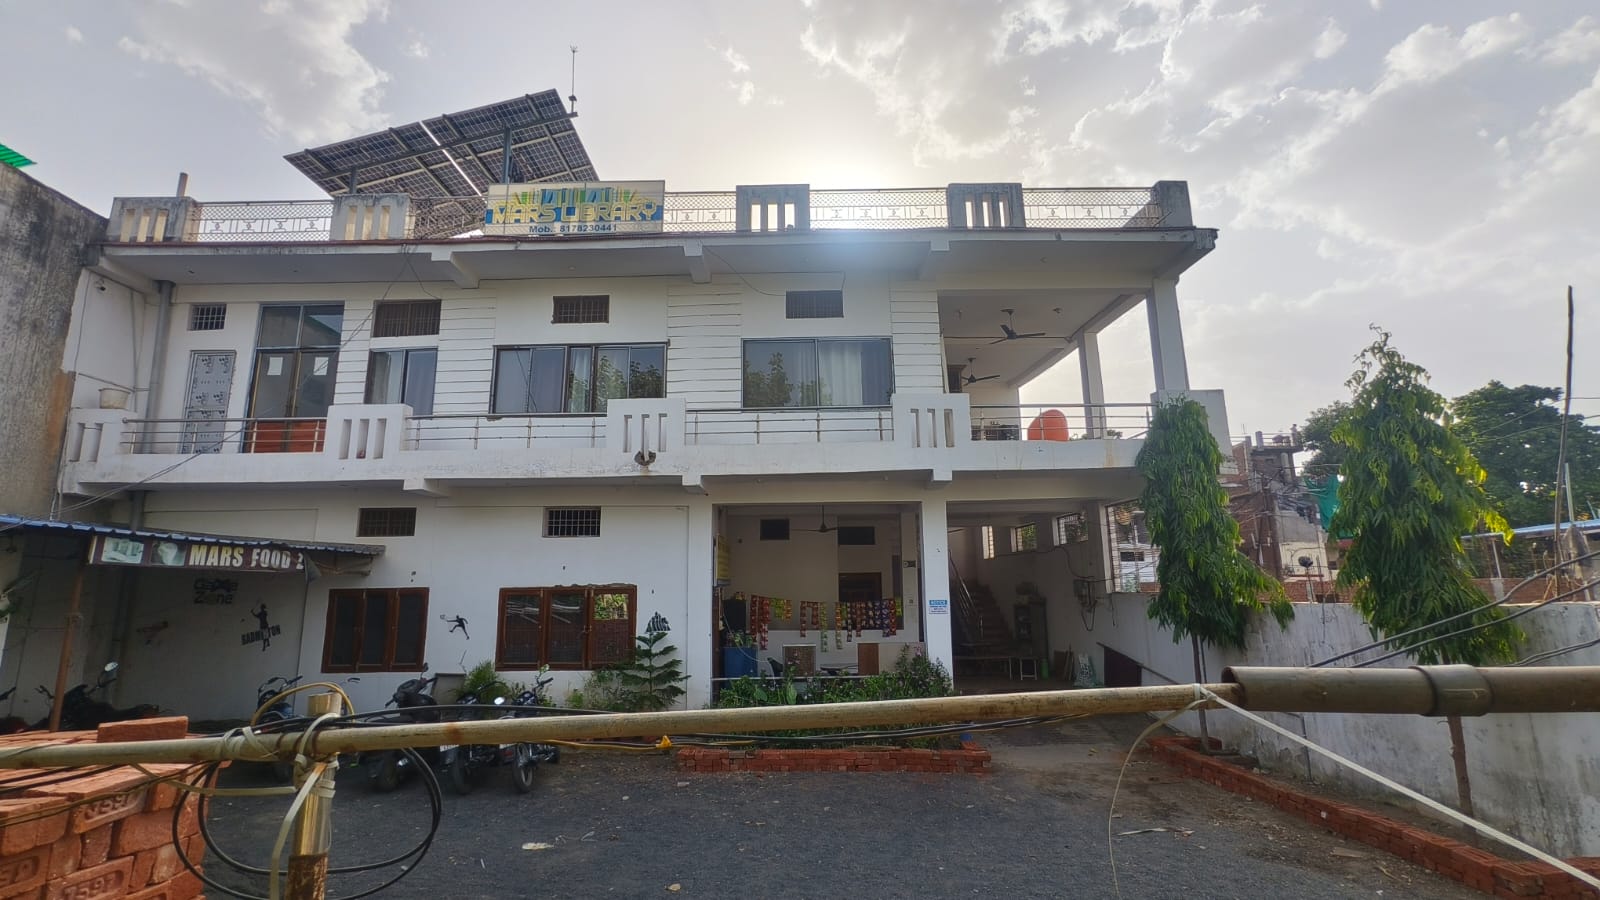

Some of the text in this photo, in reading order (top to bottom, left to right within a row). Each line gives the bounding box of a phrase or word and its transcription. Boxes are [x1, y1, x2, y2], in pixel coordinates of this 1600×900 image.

[492, 201, 658, 224] MARS LIBRARY
[189, 545, 244, 566] MARS
[250, 548, 291, 569] FOOD
